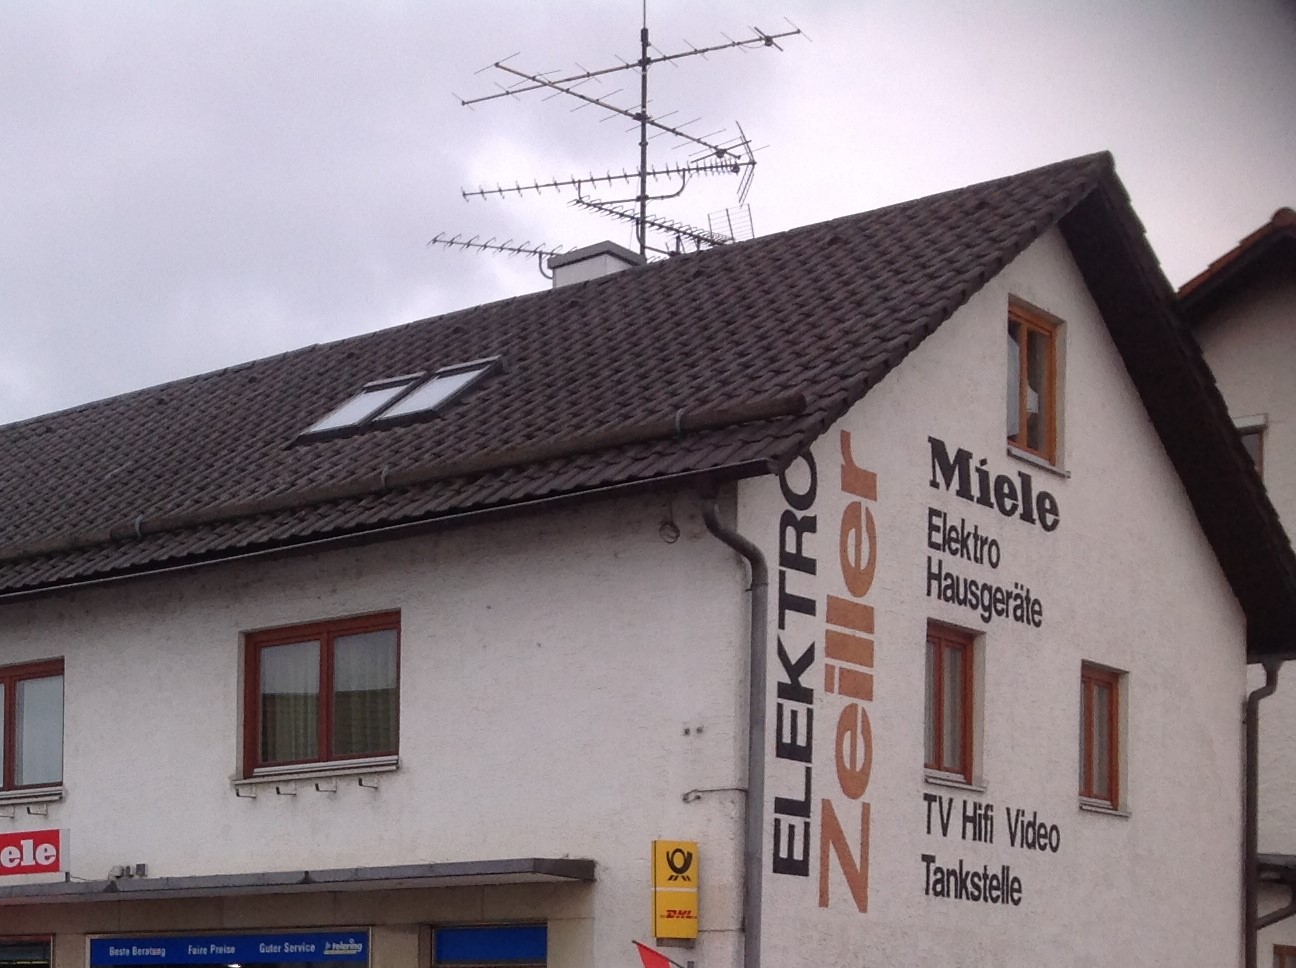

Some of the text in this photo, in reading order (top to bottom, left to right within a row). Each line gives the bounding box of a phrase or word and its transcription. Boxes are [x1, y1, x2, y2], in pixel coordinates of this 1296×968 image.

[928, 436, 1060, 532] Miele
[927, 507, 1000, 568] Elektro
[926, 555, 1043, 628] Hausgeräte
[772, 451, 817, 876] ELEKTRO
[818, 430, 878, 913] Zeiller
[923, 793, 1061, 853] TV Hifi Video
[921, 853, 1022, 906] Tankstelle
[109, 946, 130, 957] Beste
[132, 946, 166, 957] Beratung
[188, 944, 208, 955] Faire
[210, 944, 236, 954] Preise
[259, 943, 280, 954] Guter
[284, 942, 316, 953] Service
